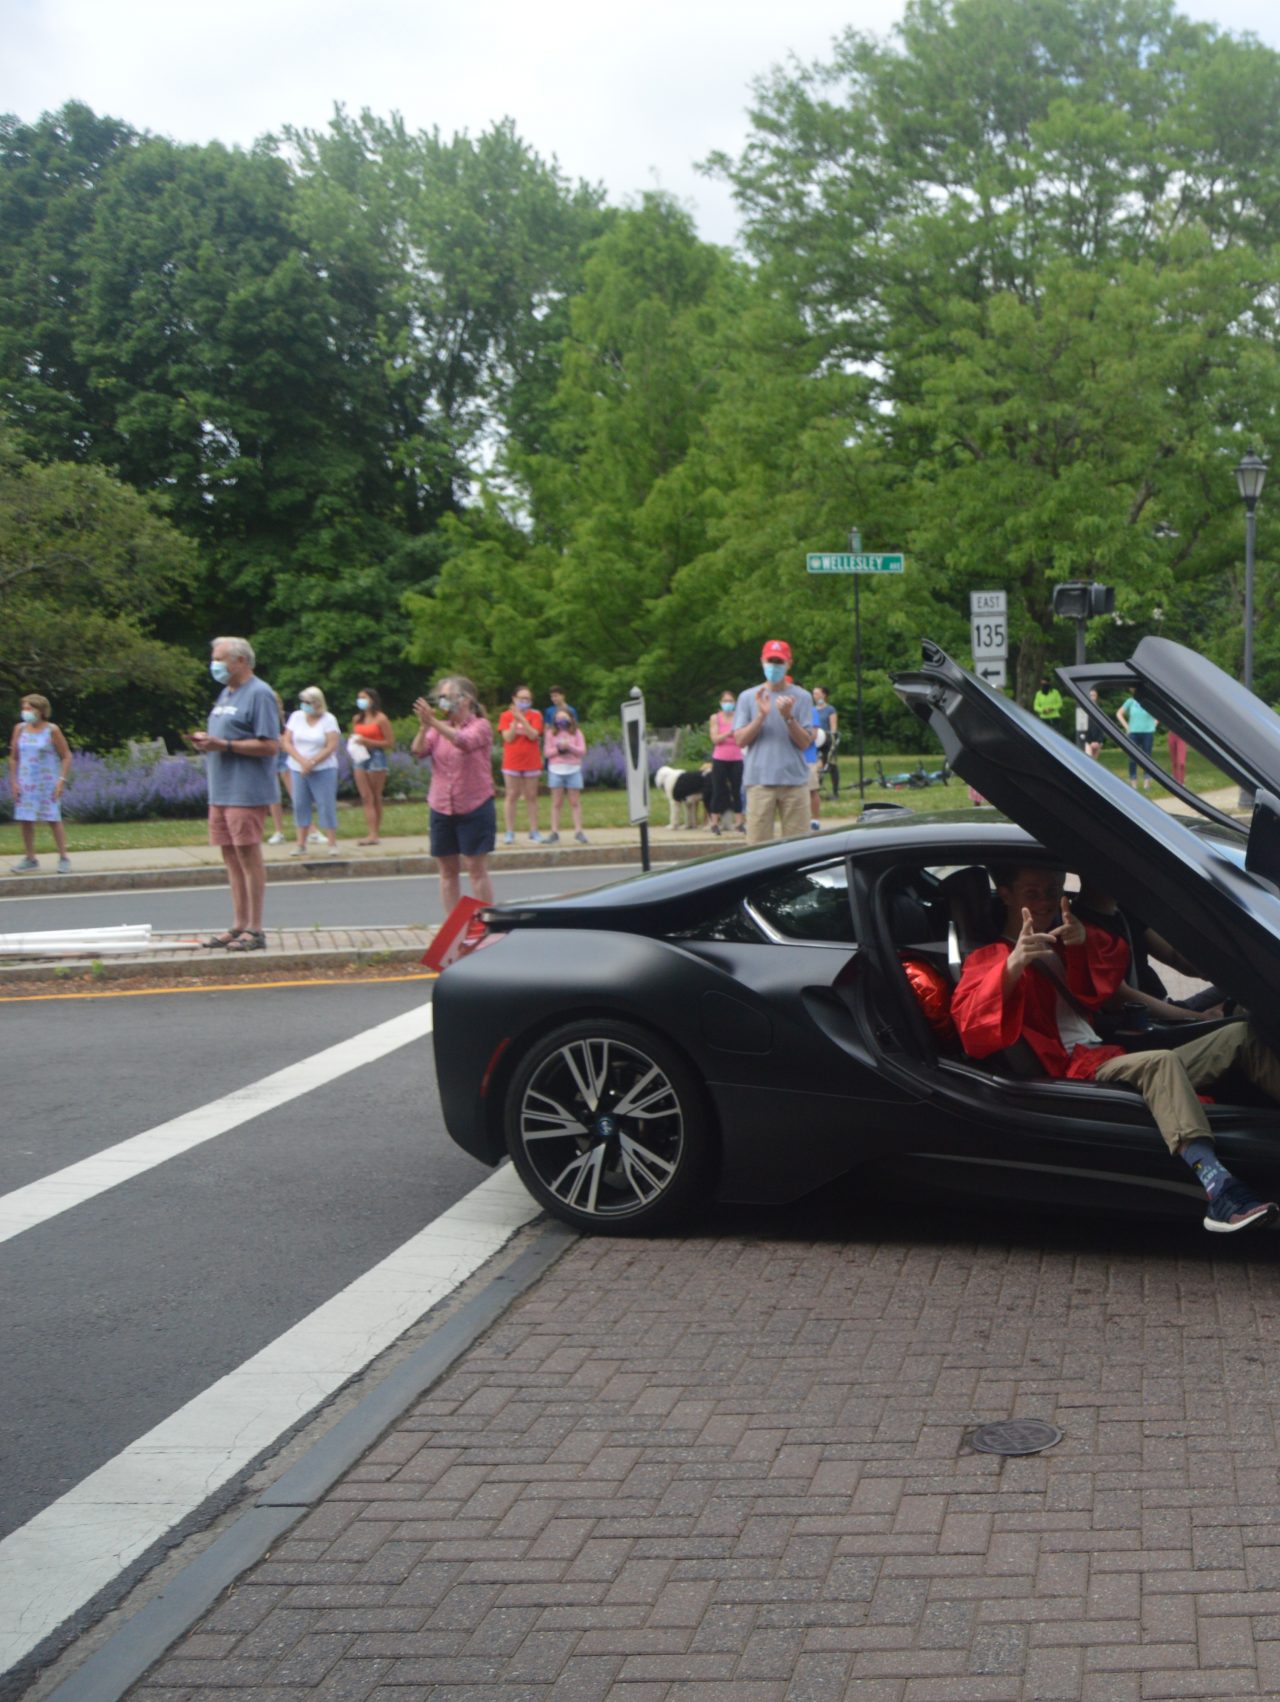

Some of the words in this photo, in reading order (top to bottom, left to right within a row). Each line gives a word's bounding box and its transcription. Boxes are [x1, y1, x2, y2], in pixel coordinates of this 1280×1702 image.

[822, 556, 883, 570] WELLESLEY
[977, 596, 1000, 608] EAST
[975, 624, 1005, 647] 135
